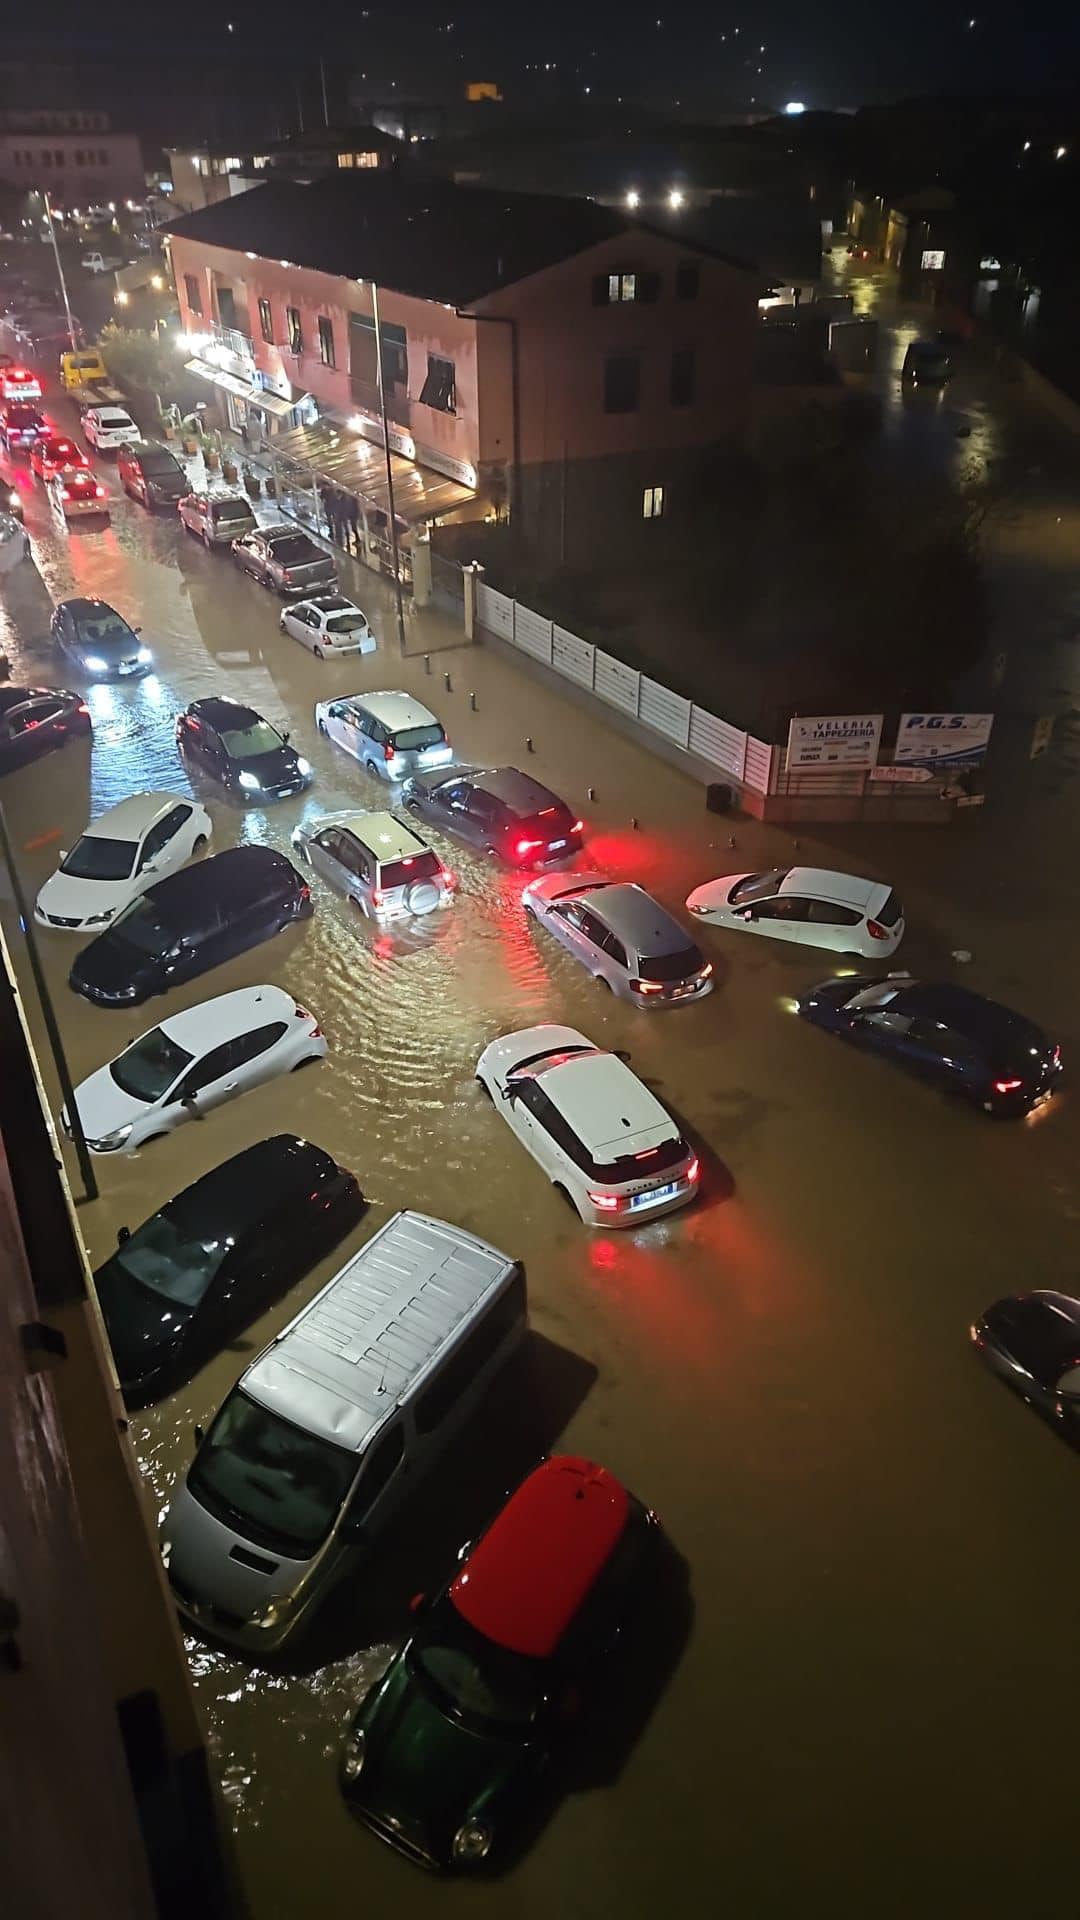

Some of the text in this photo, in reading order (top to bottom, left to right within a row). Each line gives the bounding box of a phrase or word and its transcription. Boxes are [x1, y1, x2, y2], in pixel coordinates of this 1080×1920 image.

[817, 720, 873, 729] VELERIA
[906, 716, 967, 729] P.G.S.
[813, 729, 875, 738] TAPPEZZERIA
